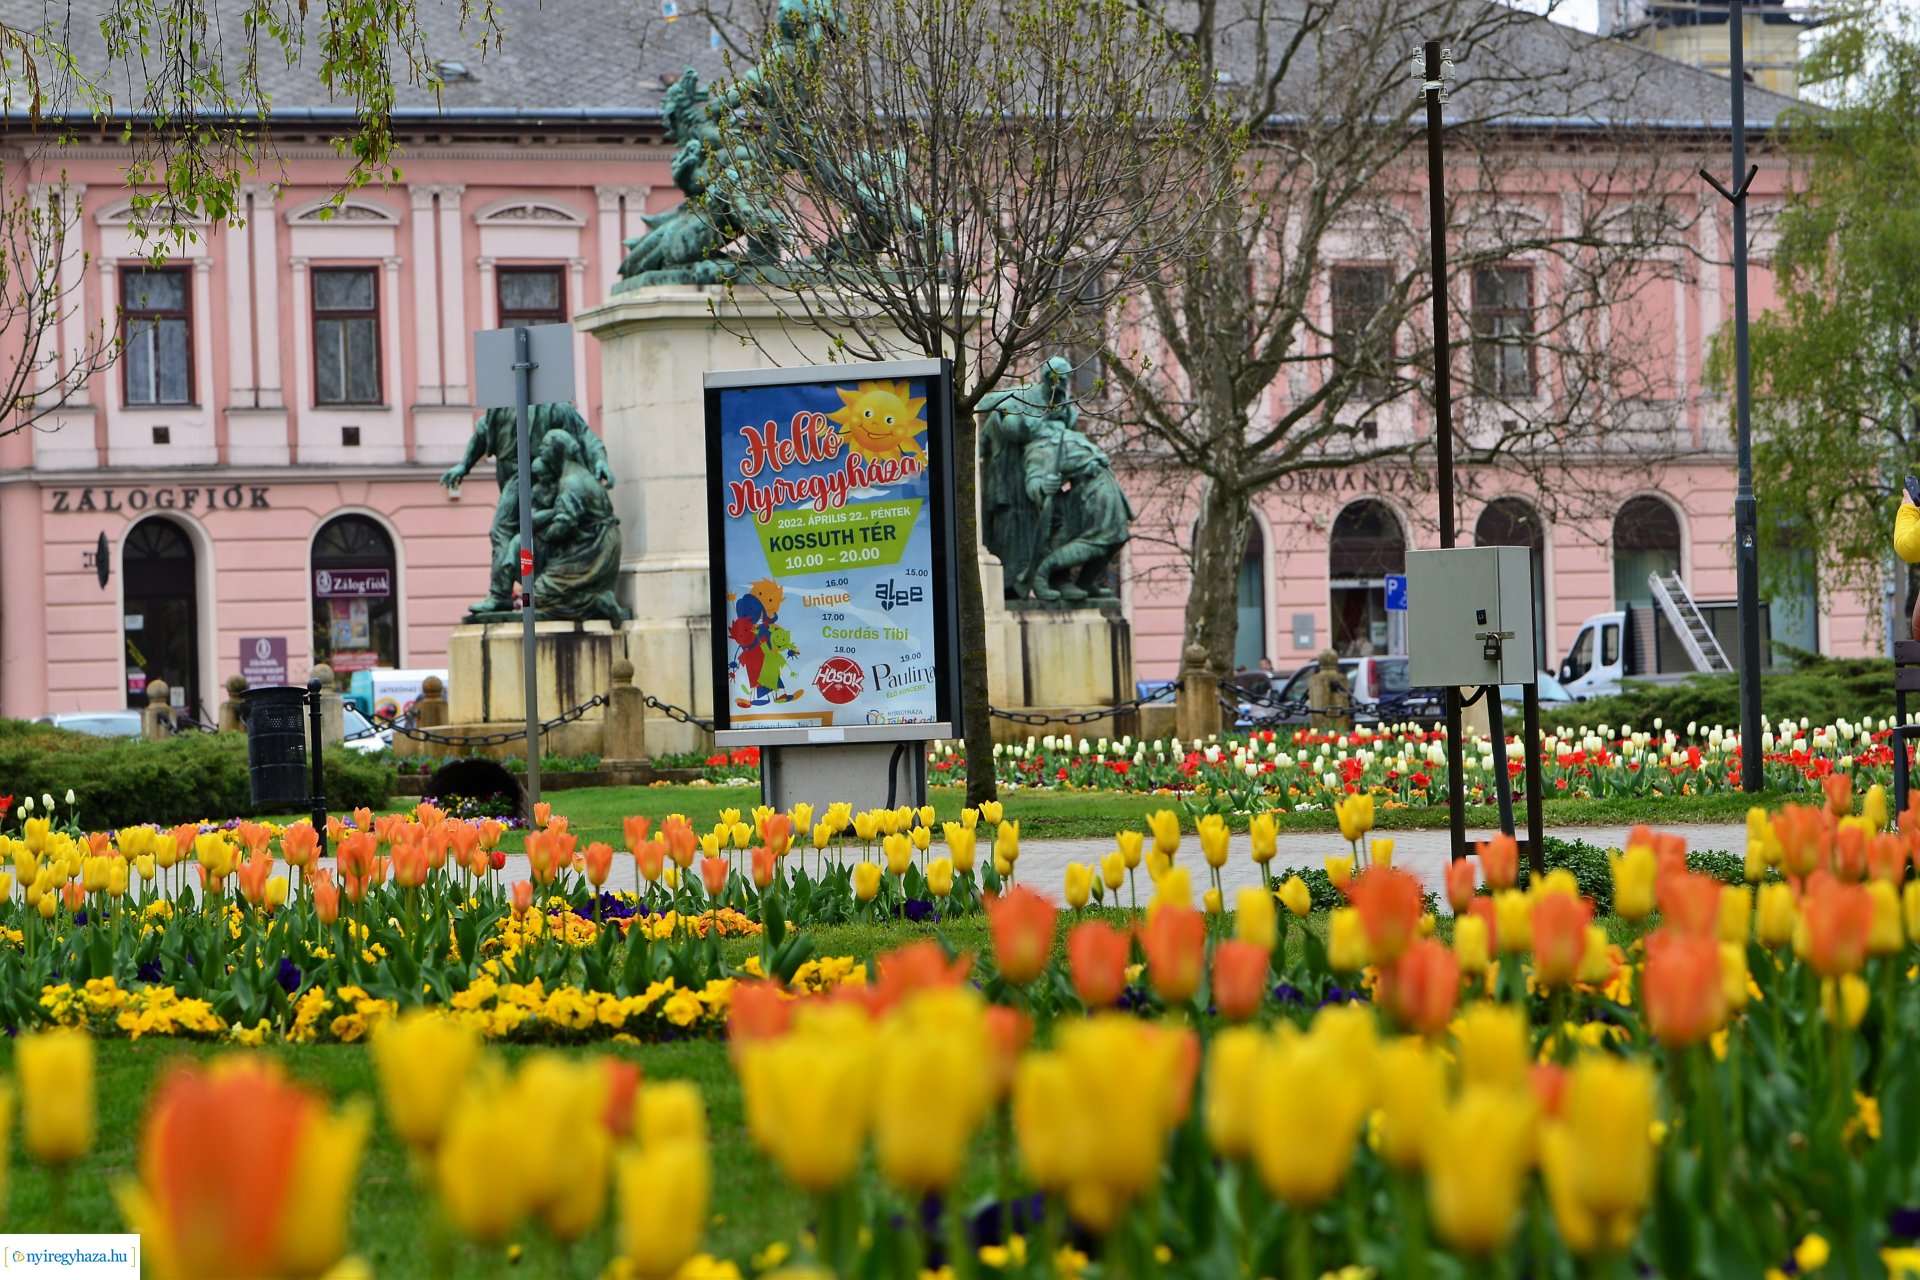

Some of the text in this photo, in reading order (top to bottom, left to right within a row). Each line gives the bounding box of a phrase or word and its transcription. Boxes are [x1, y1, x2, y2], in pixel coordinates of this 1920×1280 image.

[740, 410, 843, 477] Helló
[53, 483, 270, 513] ZÁLOGFIÓK
[778, 505, 911, 529] 2022. ÁPRILIS 22., PÉNTEK
[769, 521, 897, 553] KOSSUTH TÉR
[785, 553, 824, 570] 10.00
[839, 547, 880, 564] 20.00
[905, 568, 929, 577] 15.00
[333, 577, 389, 594] Zálogfiók
[825, 578, 849, 588] 16.00
[1388, 579, 1398, 595] P
[802, 591, 851, 608] Unique
[822, 613, 845, 621] 17.00
[822, 625, 909, 641] Csordás Tibi
[834, 646, 856, 654] 18.00
[900, 652, 922, 663] 19.00
[871, 663, 936, 692] Paulina
